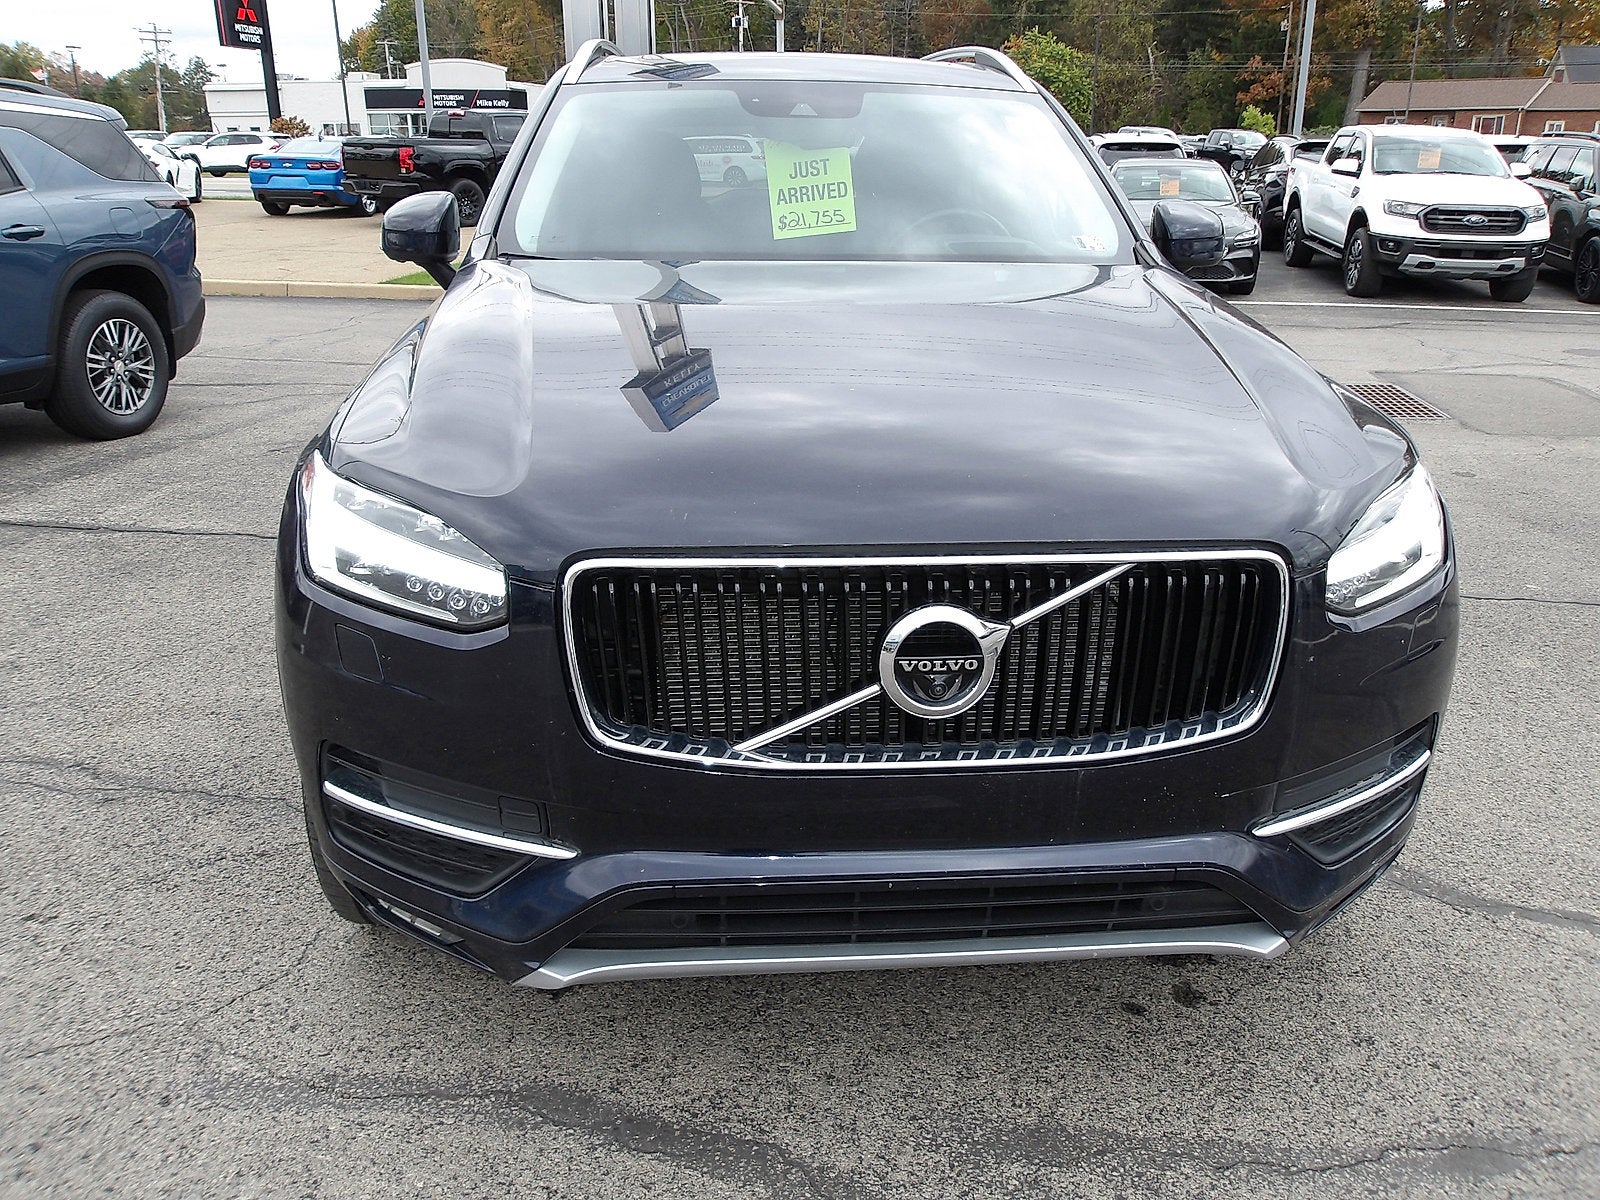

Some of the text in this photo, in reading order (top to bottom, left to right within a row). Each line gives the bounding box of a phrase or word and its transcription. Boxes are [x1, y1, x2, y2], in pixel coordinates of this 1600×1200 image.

[234, 23, 263, 35] MITSUBISHI
[239, 32, 262, 44] MOTORS
[476, 99, 509, 108] Mike Kelly
[788, 158, 830, 180] JUST
[776, 181, 848, 206] ARRIVED
[778, 209, 846, 232] $21,755
[898, 659, 979, 672] VOLVO
